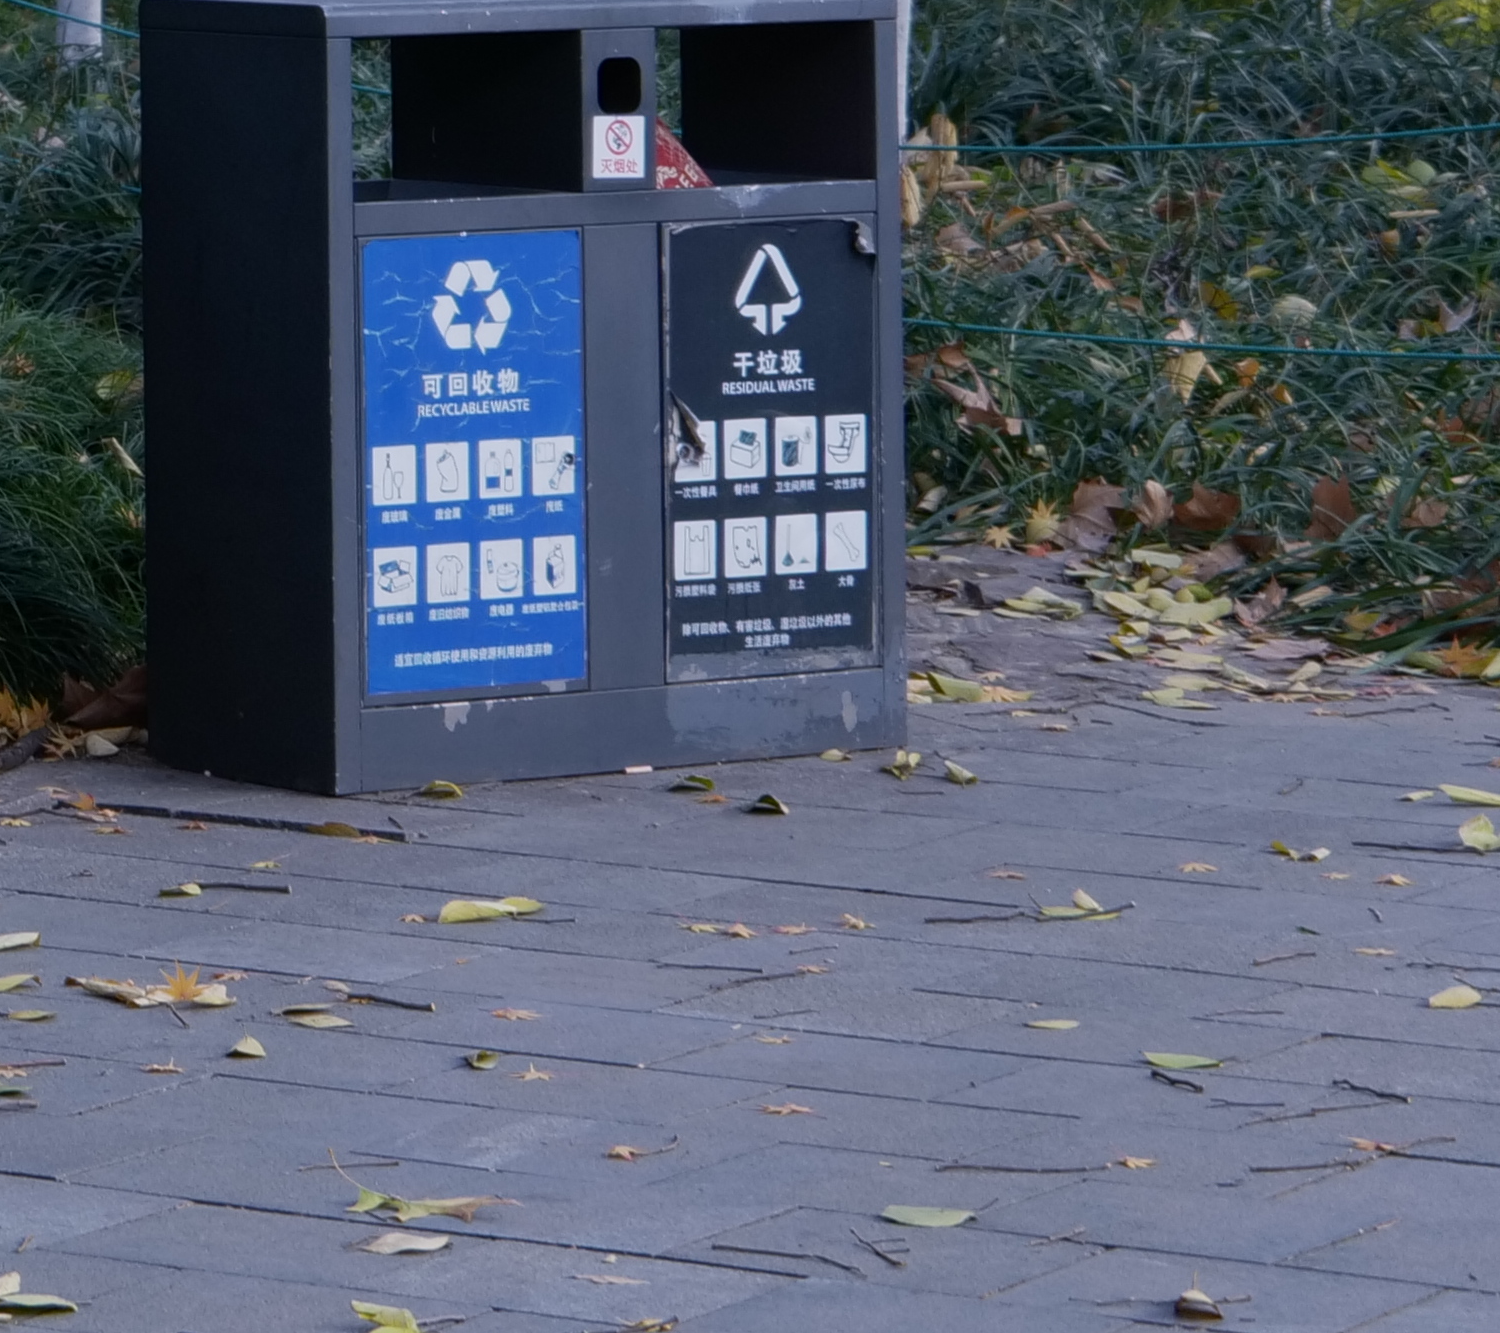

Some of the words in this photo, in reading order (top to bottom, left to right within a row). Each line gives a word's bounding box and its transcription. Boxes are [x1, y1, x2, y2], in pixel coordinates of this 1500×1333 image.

[601, 158, 638, 174] 灭烟处
[733, 349, 803, 377] 干垃圾
[422, 368, 519, 399] 可回收物
[722, 380, 776, 395] RESIDUAL
[777, 377, 816, 392] WASTE
[417, 401, 490, 418] RECYCLABLE
[490, 398, 530, 413] WASTE
